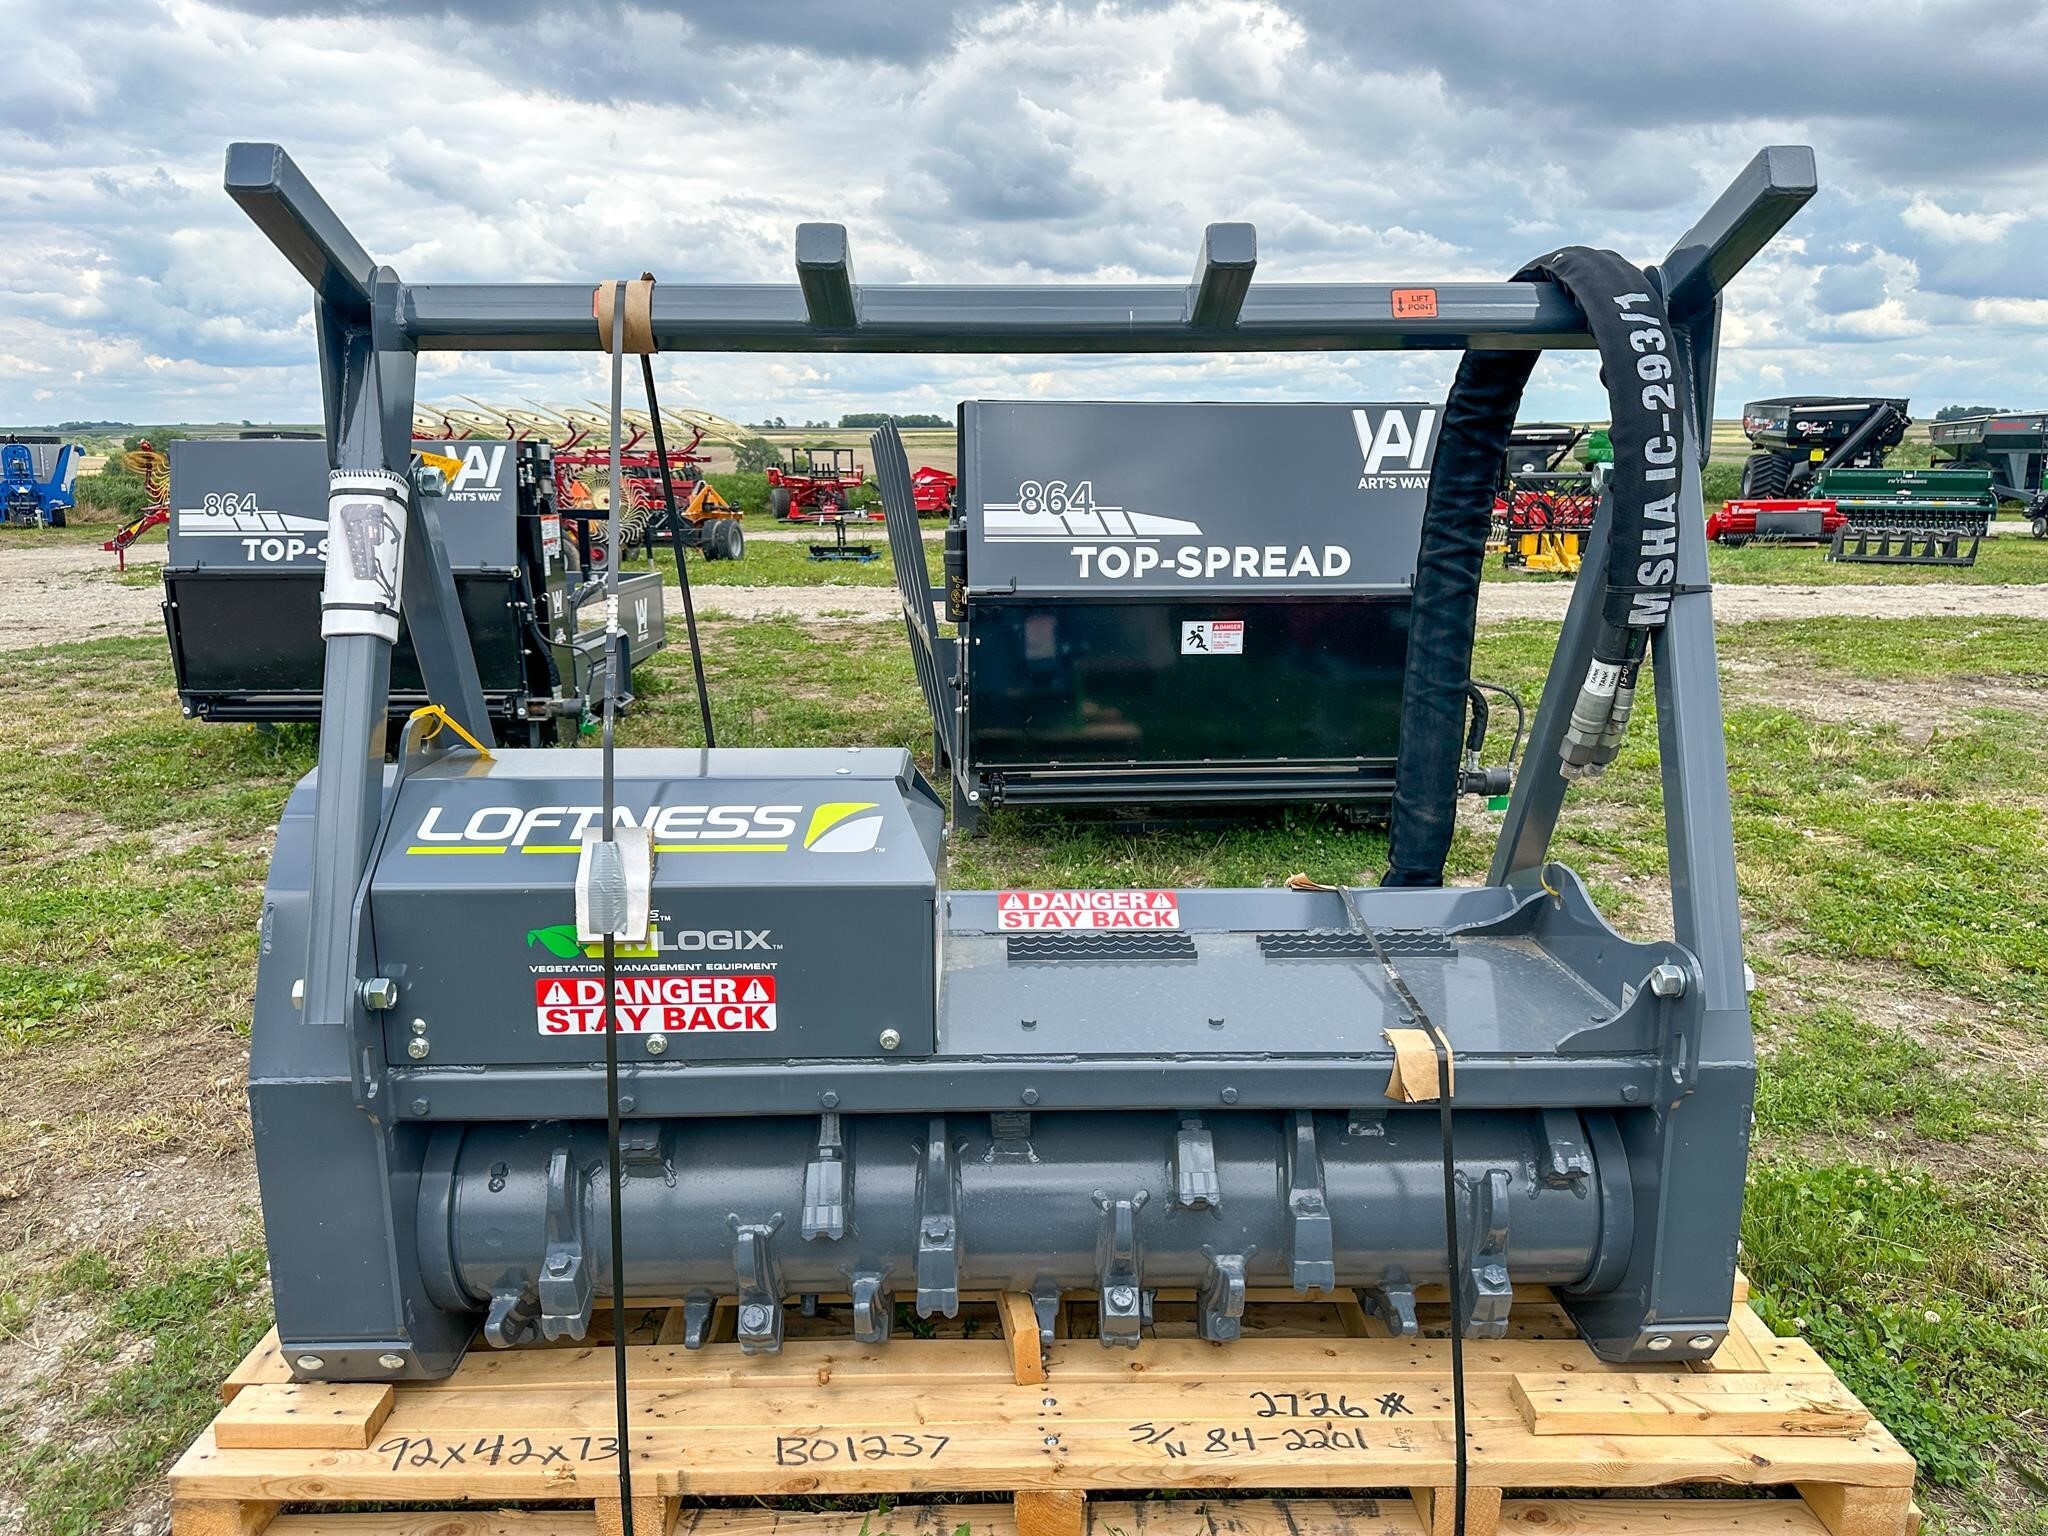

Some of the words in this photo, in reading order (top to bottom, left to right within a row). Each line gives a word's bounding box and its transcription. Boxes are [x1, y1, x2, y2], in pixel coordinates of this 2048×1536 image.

[1612, 292, 1676, 482] IC-293/1
[1357, 477, 1397, 490] ART'S
[1400, 477, 1431, 490] WAY
[203, 493, 258, 517] 864
[478, 492, 502, 502] WAY
[1018, 480, 1095, 515] 864
[241, 538, 329, 561] TOP-S
[1070, 545, 1352, 579] TOP-SPREAD
[1627, 491, 1676, 625] MSHA
[1590, 667, 1600, 684] TANK
[1599, 671, 1610, 687] TANK
[416, 805, 803, 846] LOFTNESS
[1028, 893, 1148, 910] DANGER
[1004, 911, 1083, 928] STAY
[1092, 911, 1174, 928] BACK
[529, 964, 605, 973] VEGETATION
[613, 963, 702, 972] MANAGEMENT
[705, 962, 779, 971] EQUIPMENT
[576, 978, 737, 1005] DANGER
[663, 1005, 770, 1031] BACK
[1250, 1391, 1369, 1418] 2726
[1204, 1426, 1369, 1452] 84-2201
